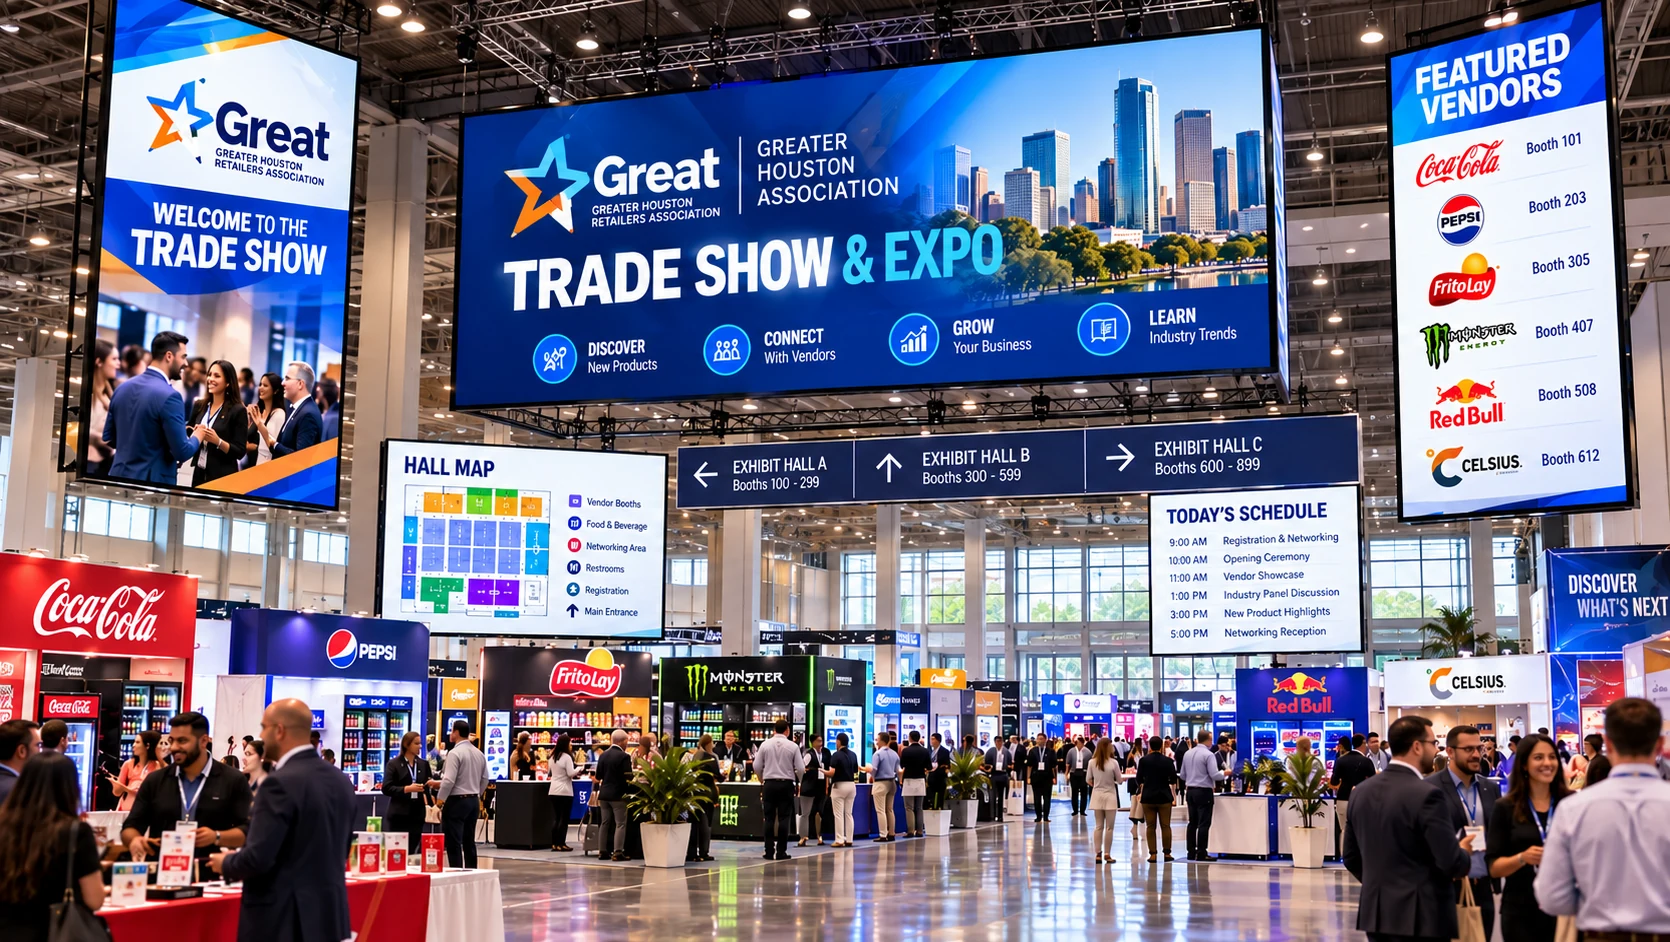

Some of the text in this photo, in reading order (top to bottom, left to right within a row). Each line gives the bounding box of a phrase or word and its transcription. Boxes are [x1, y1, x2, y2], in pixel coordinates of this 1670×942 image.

[1415, 32, 1571, 95] FEATURED
[1421, 67, 1563, 125] VENDORS
[215, 101, 331, 162] Great
[757, 132, 848, 158] GREATER
[1526, 132, 1582, 155] Booth 101
[216, 147, 303, 172] GREATER HOUSTON
[757, 155, 855, 182] HOUSTON
[214, 158, 325, 187] RETAILERS ASSOCIATION
[593, 147, 720, 198] Great
[757, 176, 899, 207] ASSOCIATION
[592, 197, 693, 215] GREATER HOUSTON
[1529, 191, 1587, 214] Booth 203
[153, 201, 308, 238] WELCOME TO THE
[591, 206, 721, 228] RETAILERS ASSOCIATION
[1441, 210, 1481, 229] PEPSI
[131, 228, 328, 276] TRADE SHOW
[503, 223, 1004, 312] TRADE SHOW & EXPO
[1532, 253, 1590, 275] Booth 305
[1149, 307, 1197, 326] LEARN
[953, 318, 995, 336] GROW
[1149, 326, 1237, 346] Industry Trends
[1535, 318, 1594, 339] Booth 407
[764, 328, 824, 346] CONNECT
[953, 337, 1032, 354] Your Business
[588, 339, 646, 357] DISCOVER
[764, 347, 836, 365] With Vendors
[587, 357, 658, 374] New Products
[1538, 383, 1597, 402] Booth 508
[1430, 403, 1504, 430] Red Bull
[1154, 436, 1263, 457] EXHIBIT HALL C
[404, 455, 495, 478] HALL MAP
[733, 456, 827, 474] EXHIBIT HALL A
[922, 447, 1030, 467] EXHIBIT HALL B
[1155, 461, 1197, 476] Booths
[1200, 459, 1224, 473] 600
[1236, 457, 1260, 472] 899
[1541, 449, 1600, 467] Booth 612
[733, 478, 768, 491] Booths
[771, 477, 790, 490] 100
[800, 476, 820, 489] 299
[922, 471, 962, 485] Booths
[965, 469, 987, 483] 300
[999, 468, 1021, 482] 599
[587, 498, 642, 509] Vendor Booths
[1166, 502, 1328, 525] TODAY'S SCHEDULE
[586, 519, 648, 532] Food & Beverage
[586, 542, 647, 554] Networking Area
[1169, 532, 1339, 547] 9:00 AM Registration & Networking
[585, 563, 625, 574] Restrooms
[1168, 552, 1311, 566] 10:00 AM Opening Ceremony
[1169, 570, 1305, 583] 11:00 AM Vendor Showcase
[1568, 573, 1638, 594] DISCOVER
[585, 585, 630, 597] Registration
[1170, 587, 1340, 601] 1:00 PM Industry Panel Discussion
[584, 607, 638, 617] Main Entrance
[1170, 606, 1331, 619] 3:00 PM New Product Highlights
[1577, 596, 1669, 619] WHAT'S NEXT
[1170, 626, 1327, 639] 5:00 PM Networking Reception
[359, 643, 397, 661] PEPSI
[710, 669, 785, 685] MONSTER
[1267, 697, 1298, 713] Red
